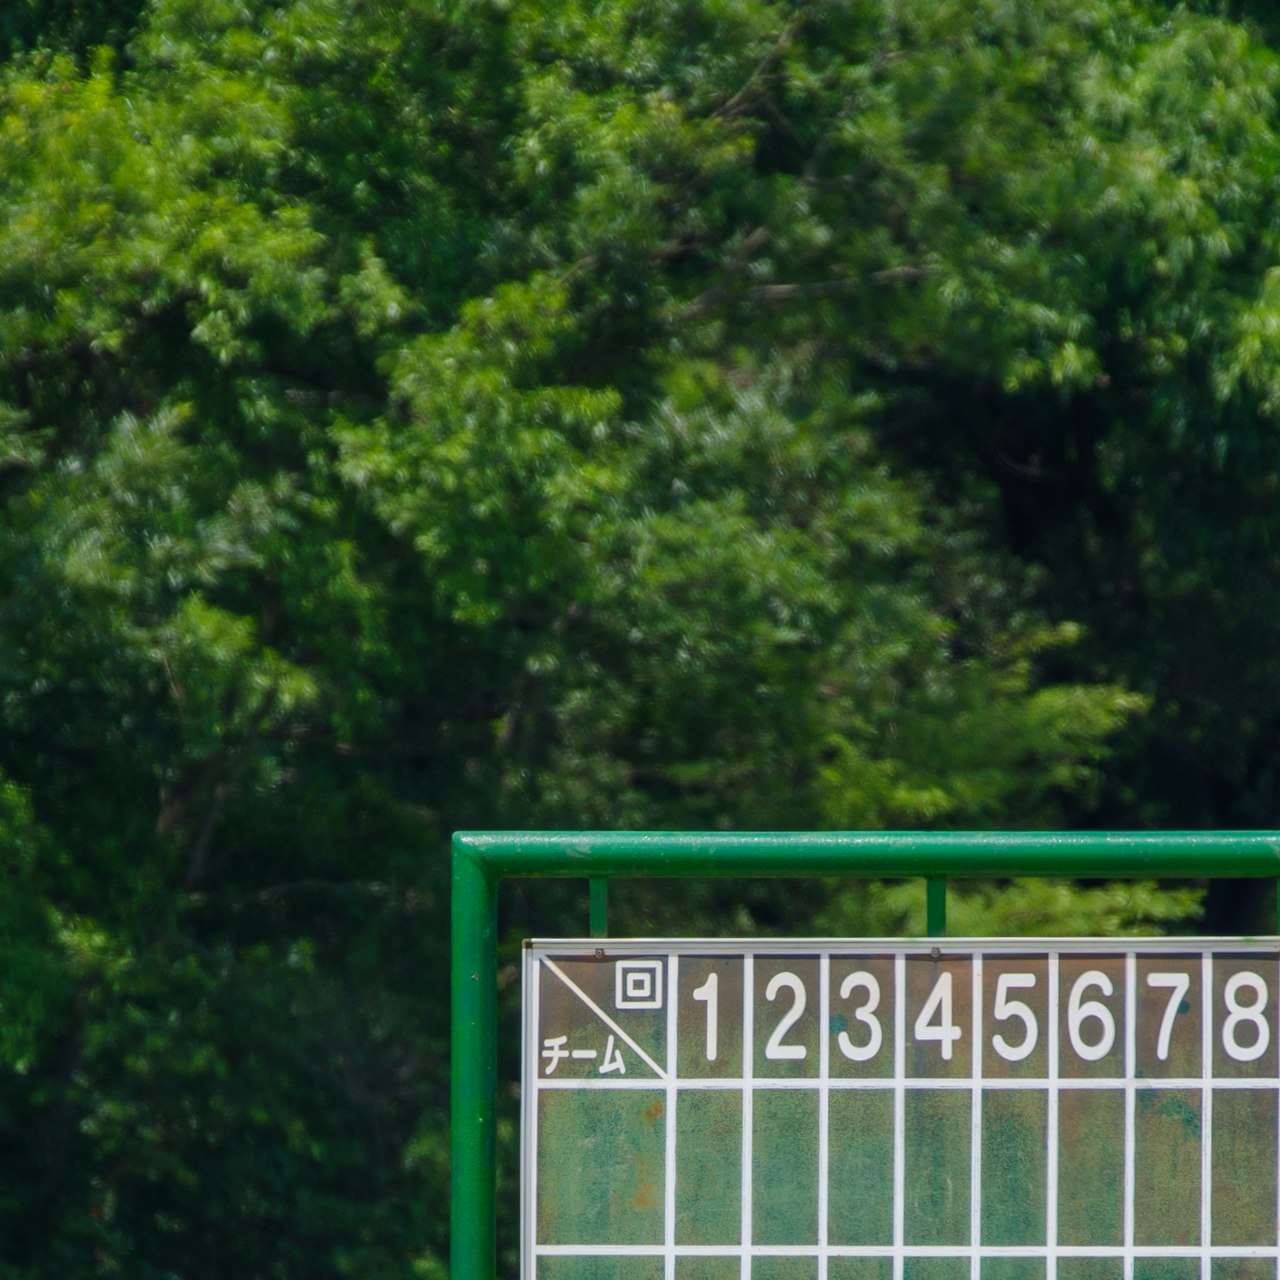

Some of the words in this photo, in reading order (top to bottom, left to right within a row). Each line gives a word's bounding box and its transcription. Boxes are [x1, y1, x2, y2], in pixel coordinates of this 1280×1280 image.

[614, 959, 663, 1010] 回
[692, 972, 719, 1062] 1
[764, 971, 808, 1060] 2
[837, 970, 883, 1062] 3
[913, 971, 963, 1061] 4
[991, 972, 1039, 1062] 5
[1067, 970, 1116, 1062] 6
[1146, 972, 1190, 1061] 7
[1221, 970, 1271, 1062] 8
[541, 1034, 626, 1076] チーム
